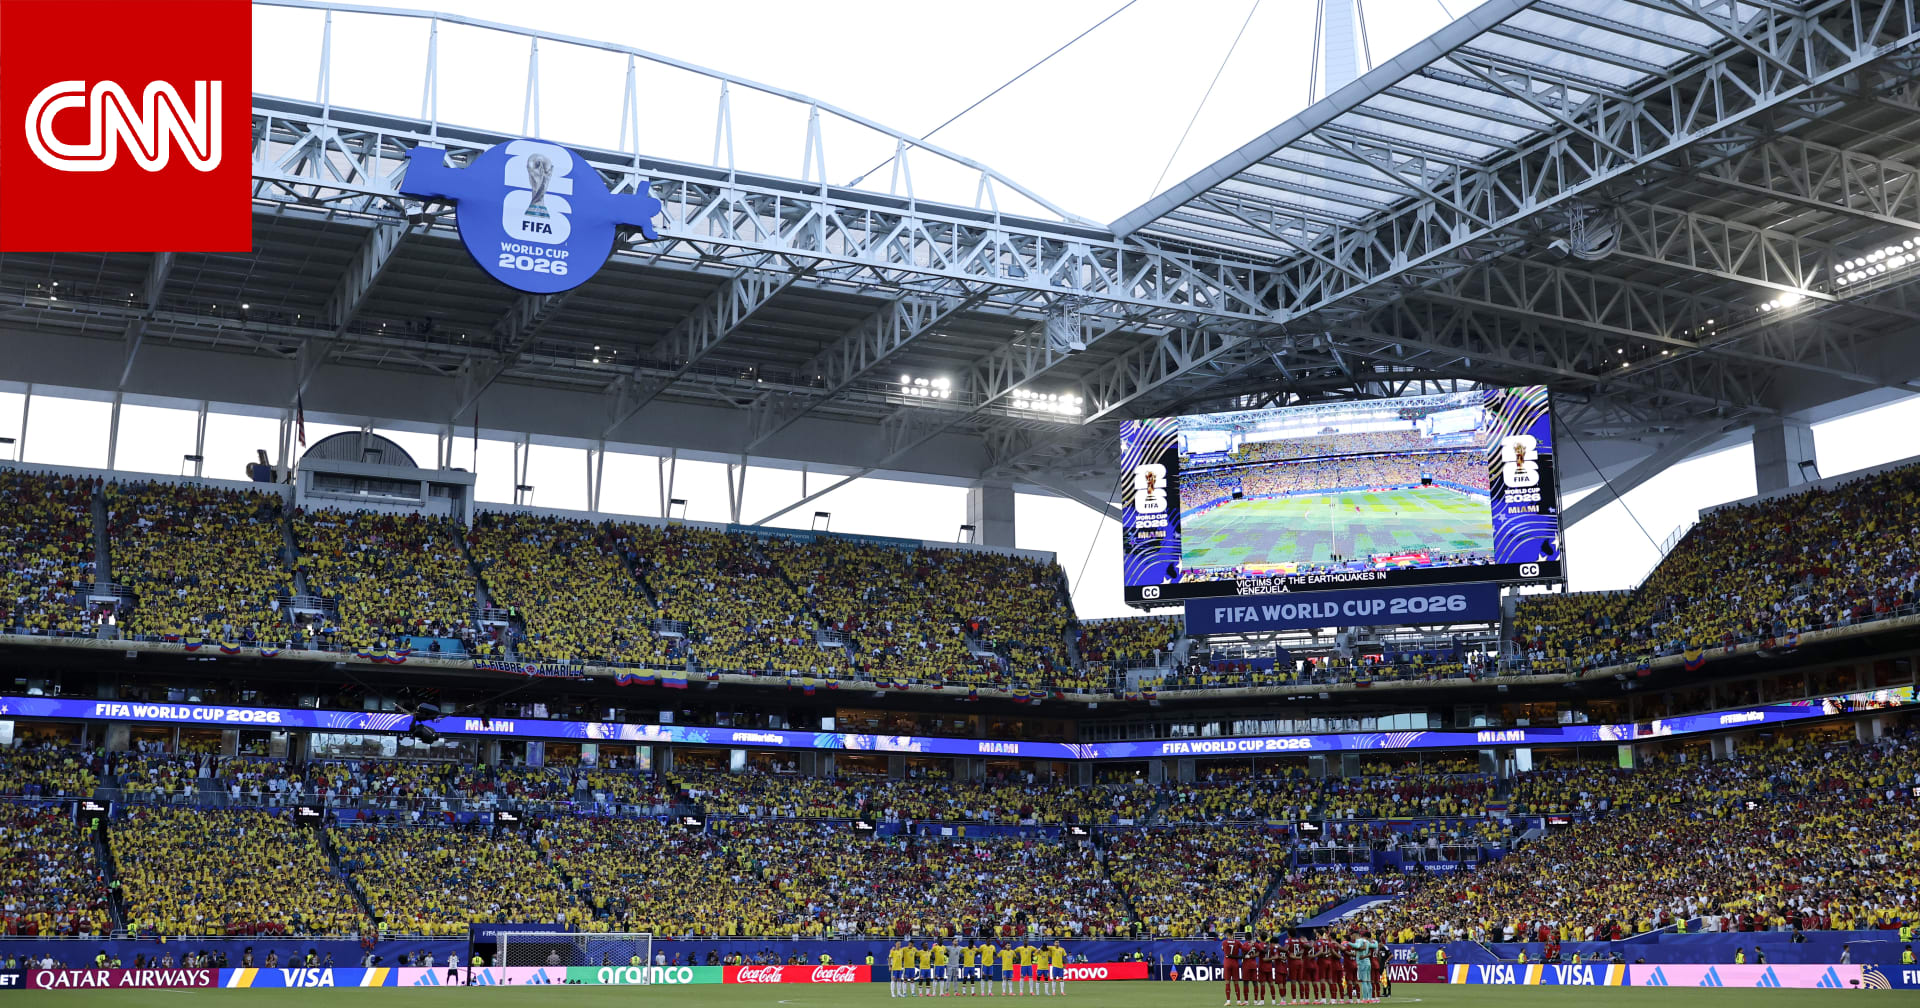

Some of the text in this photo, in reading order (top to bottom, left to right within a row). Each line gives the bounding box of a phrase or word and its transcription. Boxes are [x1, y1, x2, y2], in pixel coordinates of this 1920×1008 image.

[522, 220, 552, 235] FIFA
[500, 241, 569, 260] WORLD CUP
[498, 252, 568, 276] 2026
[1504, 493, 1541, 503] 2026
[1507, 504, 1540, 514] MIAMI
[1135, 519, 1168, 529] 2026
[1137, 530, 1166, 539] MIAMI
[1521, 565, 1537, 575] CC
[1236, 571, 1386, 588] VICTIMS OF THE EARTHQUAKES IN
[1144, 588, 1158, 597] CC
[1236, 585, 1291, 595] VENEZUELA.
[1214, 594, 1467, 623] FIFA WORLD CUP 2026
[489, 661, 521, 673] FIEBRE
[539, 664, 584, 677] AMARILLA
[95, 703, 281, 723] FIFA WORLD CUP 2026
[465, 719, 514, 733] MIAMI
[1477, 730, 1525, 743] MIAMI
[978, 742, 1019, 754] MIAMI
[1162, 738, 1311, 754] FIFA WORLD CUP 2026
[35, 969, 210, 990] QATAR AIRWAYS
[278, 968, 335, 987] VISA
[736, 966, 783, 983] Coca-Cola
[811, 965, 858, 983] Coca-Cola
[1182, 965, 1213, 981] ADI
[1477, 964, 1516, 985] VISA
[1551, 964, 1595, 986] VISA
